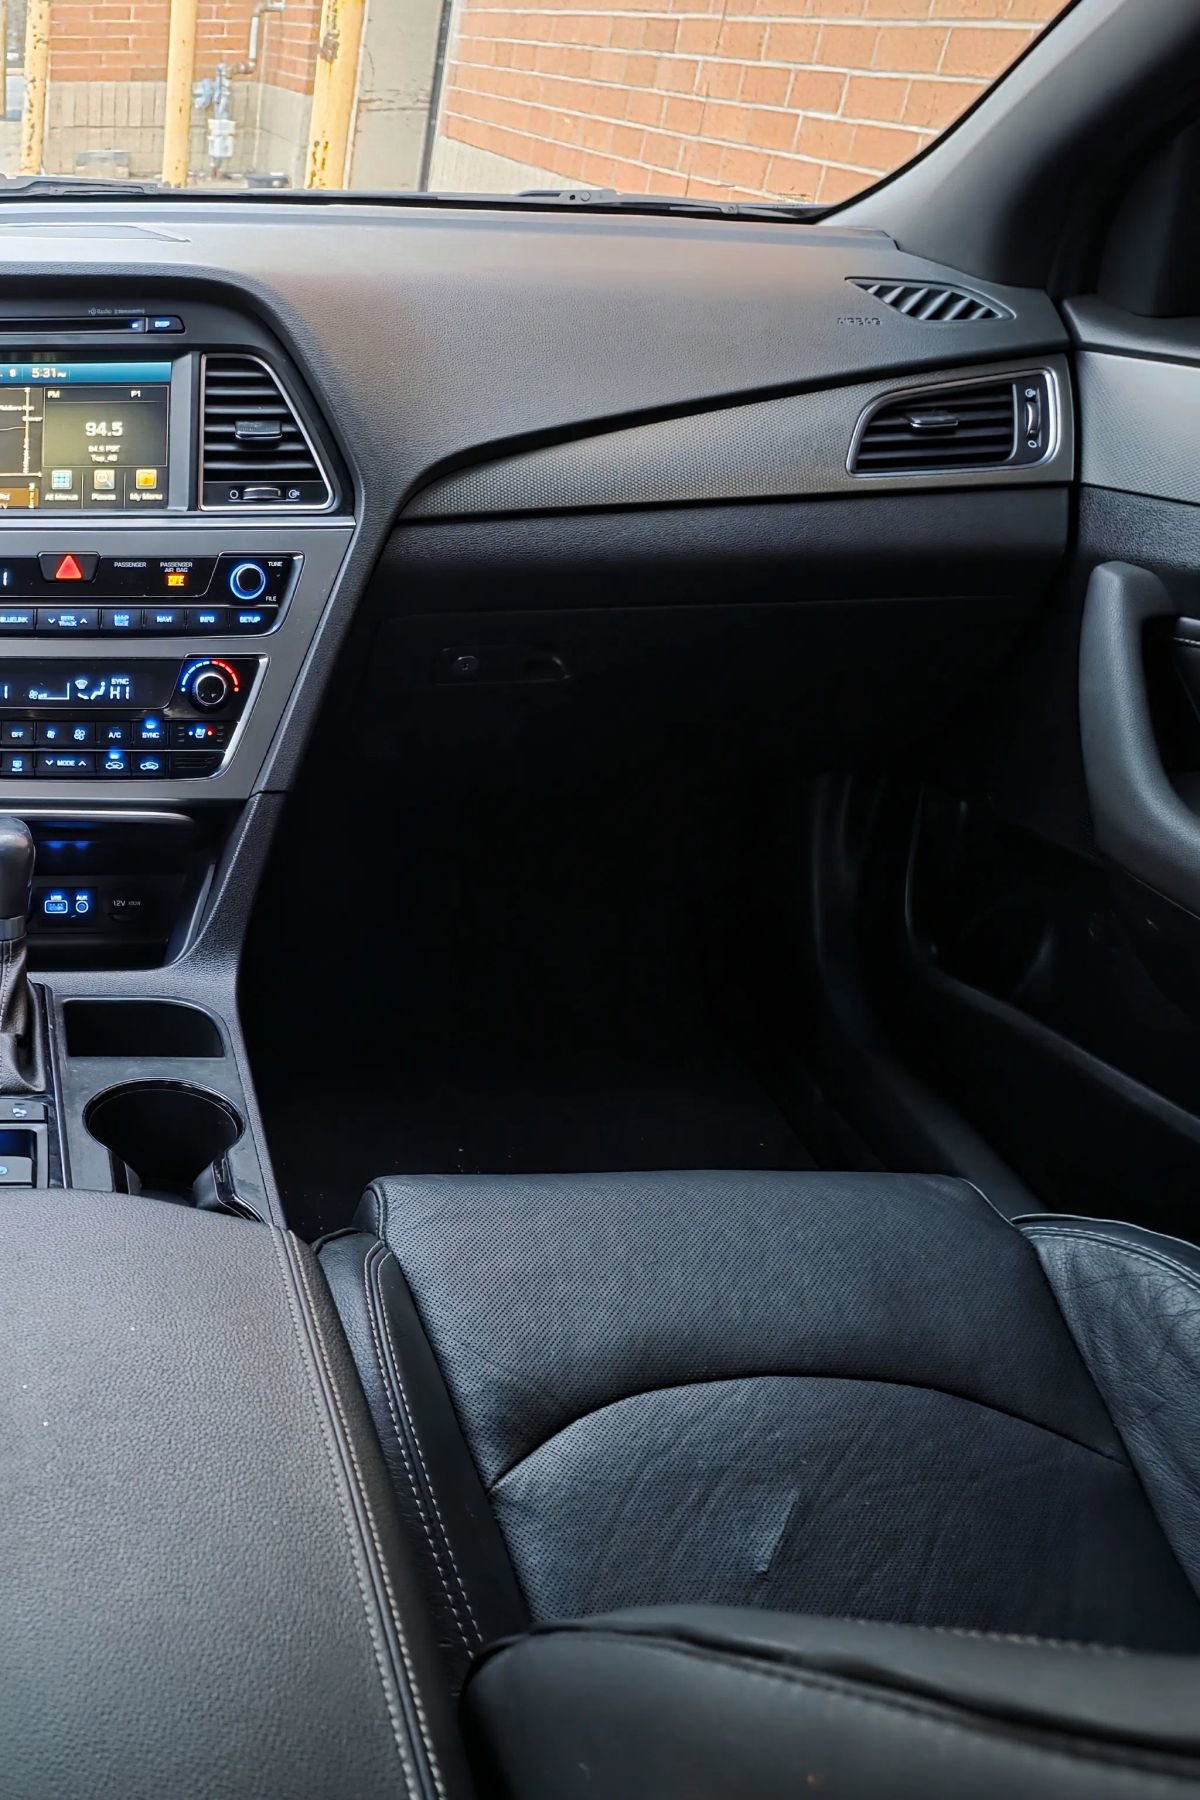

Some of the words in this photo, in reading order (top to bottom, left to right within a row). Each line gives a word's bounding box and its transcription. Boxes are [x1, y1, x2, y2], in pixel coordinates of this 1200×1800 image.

[31, 367, 57, 379] 5:31
[47, 390, 60, 399] FM
[130, 390, 141, 398] P1
[84, 421, 124, 437] 94.5
[129, 492, 141, 502] My
[142, 493, 163, 501] Menu
[156, 615, 173, 623] NAVI
[109, 686, 130, 700] HI
[56, 759, 76, 767] MODE
